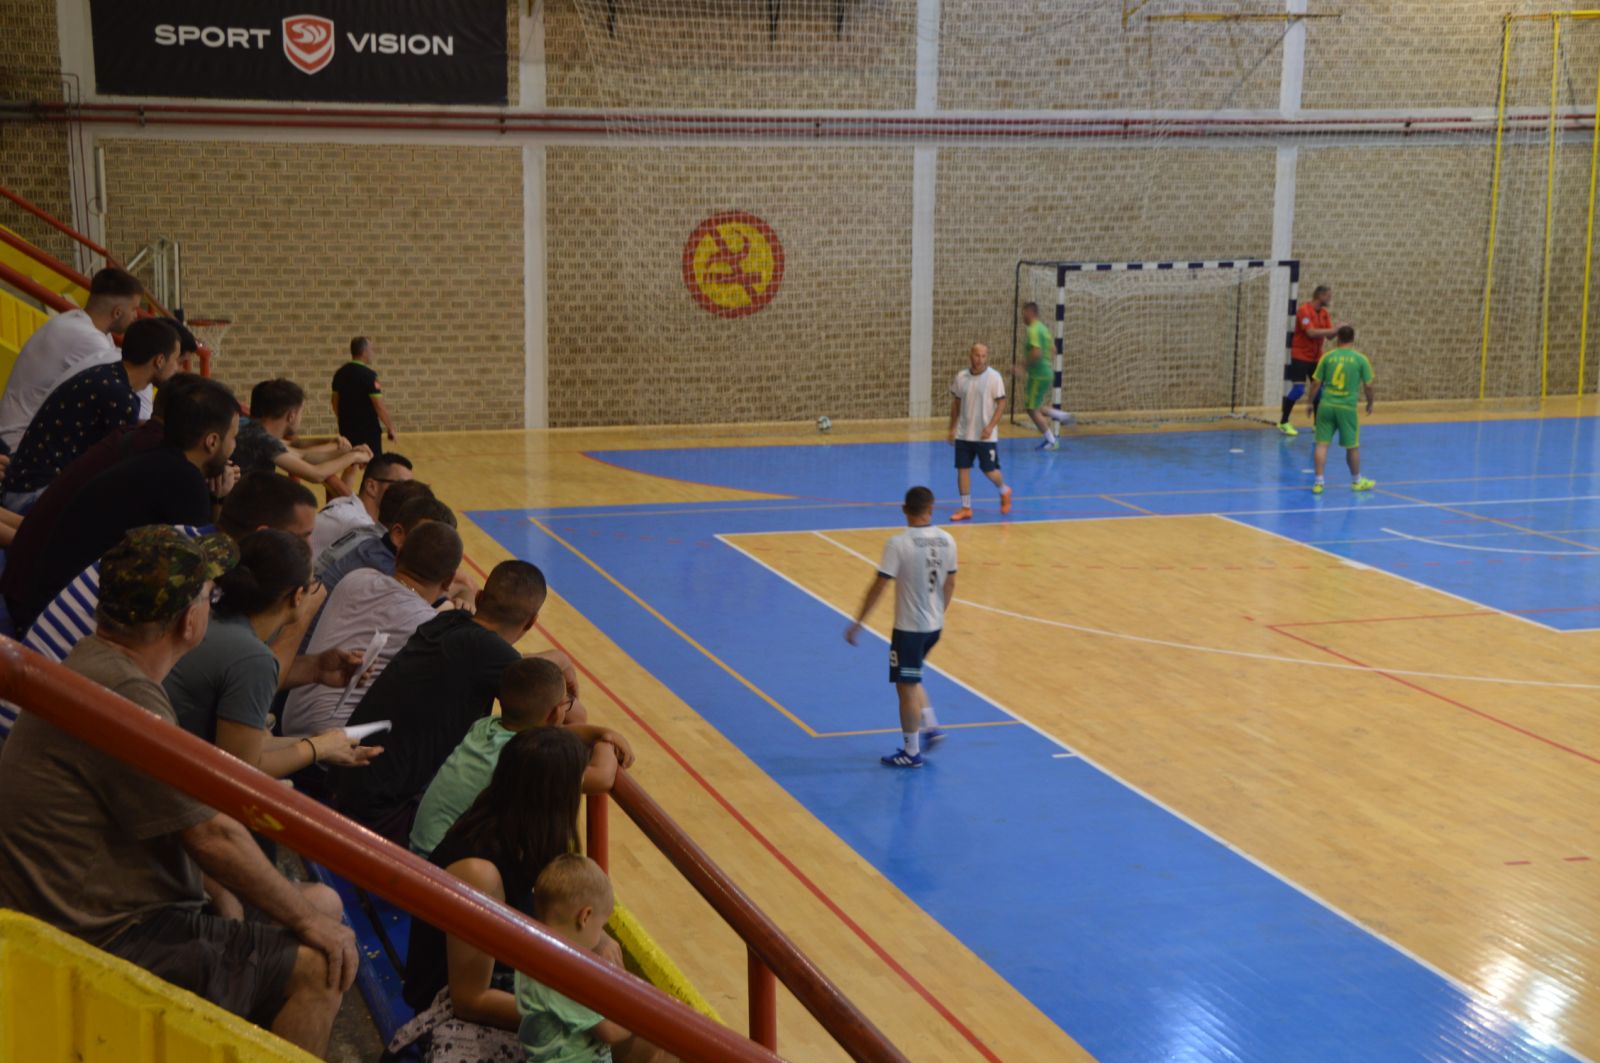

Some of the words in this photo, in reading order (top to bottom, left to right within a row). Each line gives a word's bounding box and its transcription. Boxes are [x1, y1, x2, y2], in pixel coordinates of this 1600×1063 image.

[154, 25, 271, 48] SPORT
[347, 32, 454, 55] VISION
[1332, 363, 1345, 389] 4
[928, 569, 937, 593] 9
